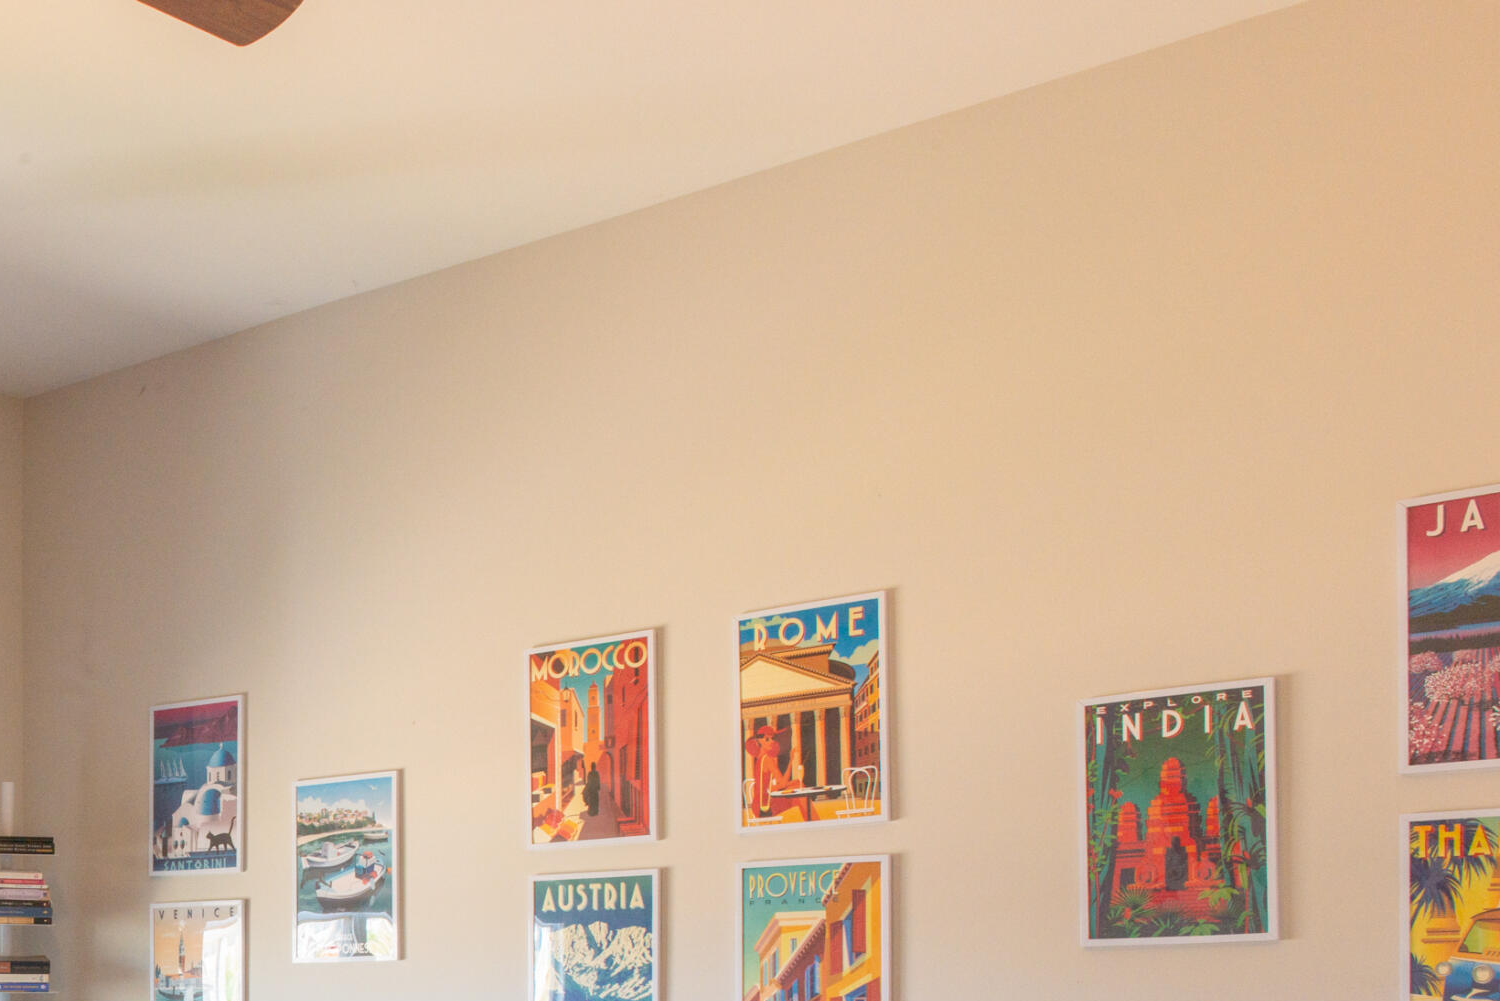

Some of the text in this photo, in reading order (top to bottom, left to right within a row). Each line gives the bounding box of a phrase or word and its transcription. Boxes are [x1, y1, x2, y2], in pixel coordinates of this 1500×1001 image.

[754, 606, 865, 651] ROME
[531, 640, 647, 682] MOROCCO
[1096, 690, 1253, 715] EXPLORE
[1097, 701, 1255, 745] INDIA
[163, 857, 227, 871] SANTORINI
[541, 881, 645, 913] AUSTRIA
[748, 869, 839, 899] PROVENCE
[158, 906, 235, 921] VENICE
[749, 896, 839, 906] FRANCE
